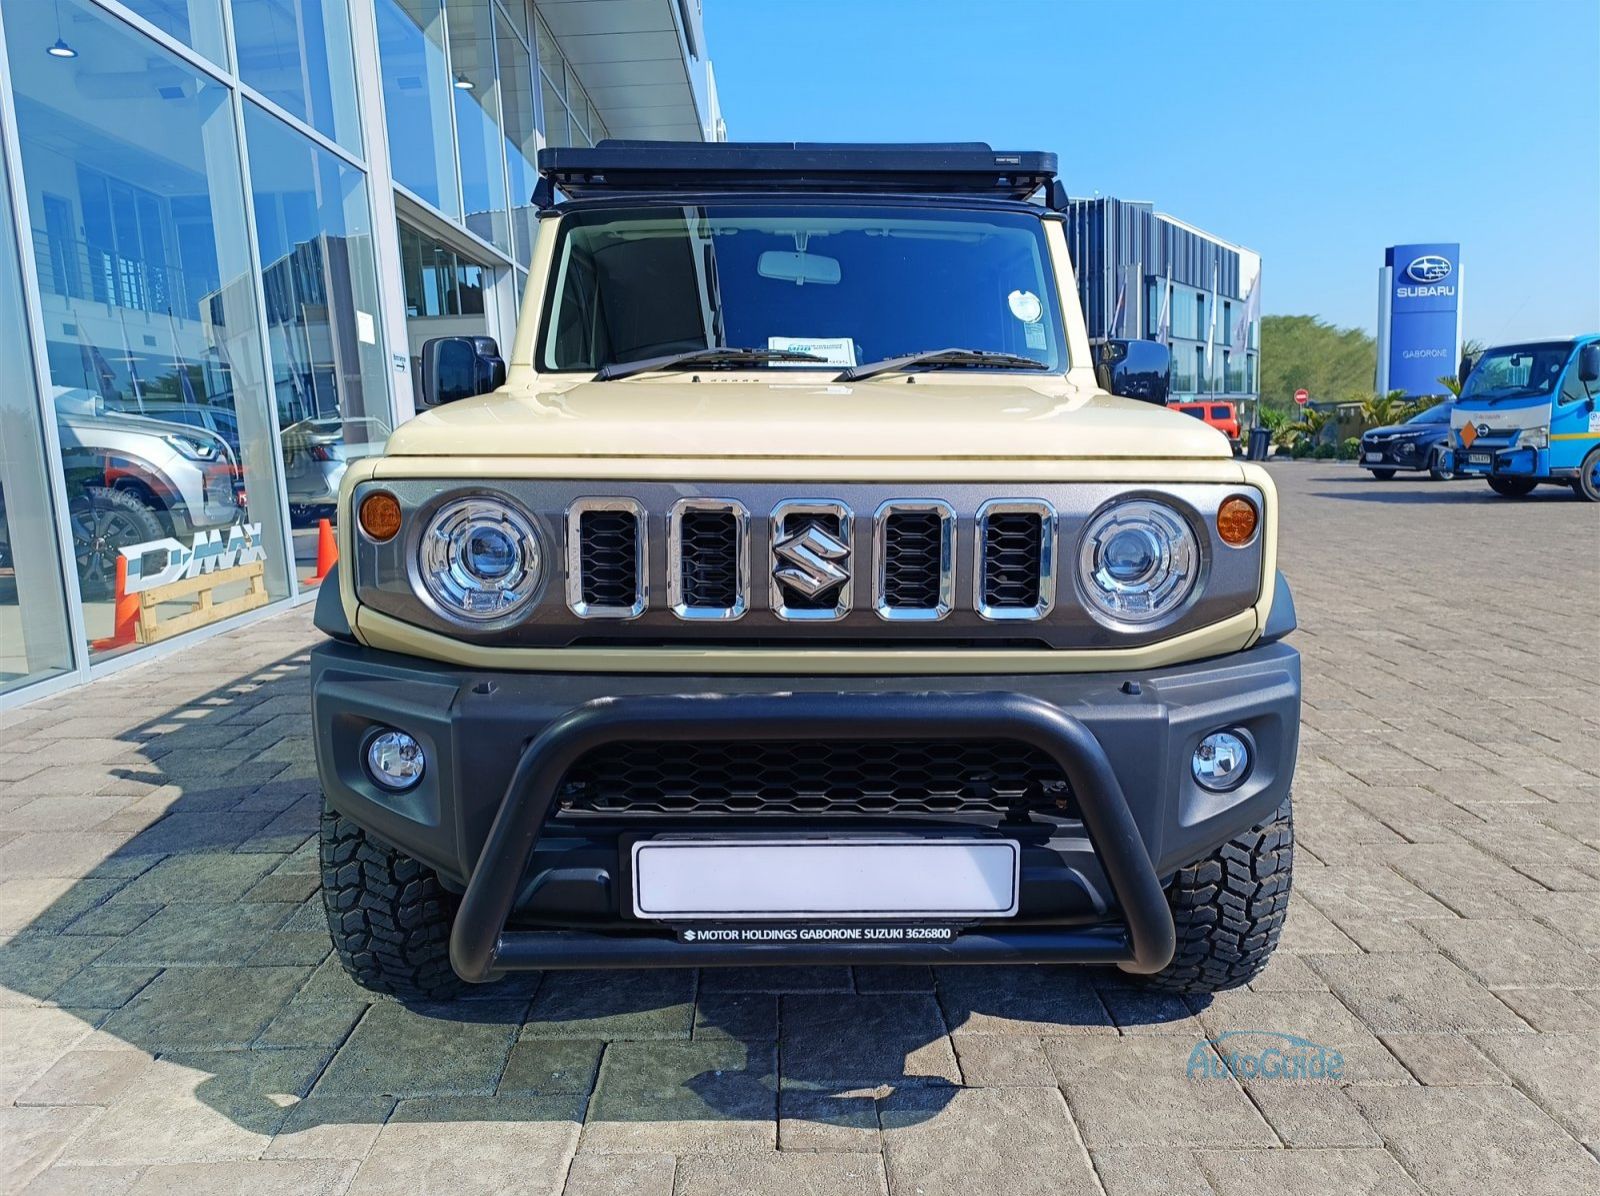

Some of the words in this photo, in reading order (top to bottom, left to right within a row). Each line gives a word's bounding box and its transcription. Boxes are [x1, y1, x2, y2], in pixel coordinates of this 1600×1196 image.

[1396, 286, 1455, 297] SUBARU
[1402, 349, 1448, 359] GABORONE
[697, 929, 740, 941] MOTOR
[741, 929, 798, 940] HOLDINGS
[799, 929, 863, 940] GABORONE
[863, 928, 904, 939] SUZUKI
[905, 927, 952, 939] 3626800
